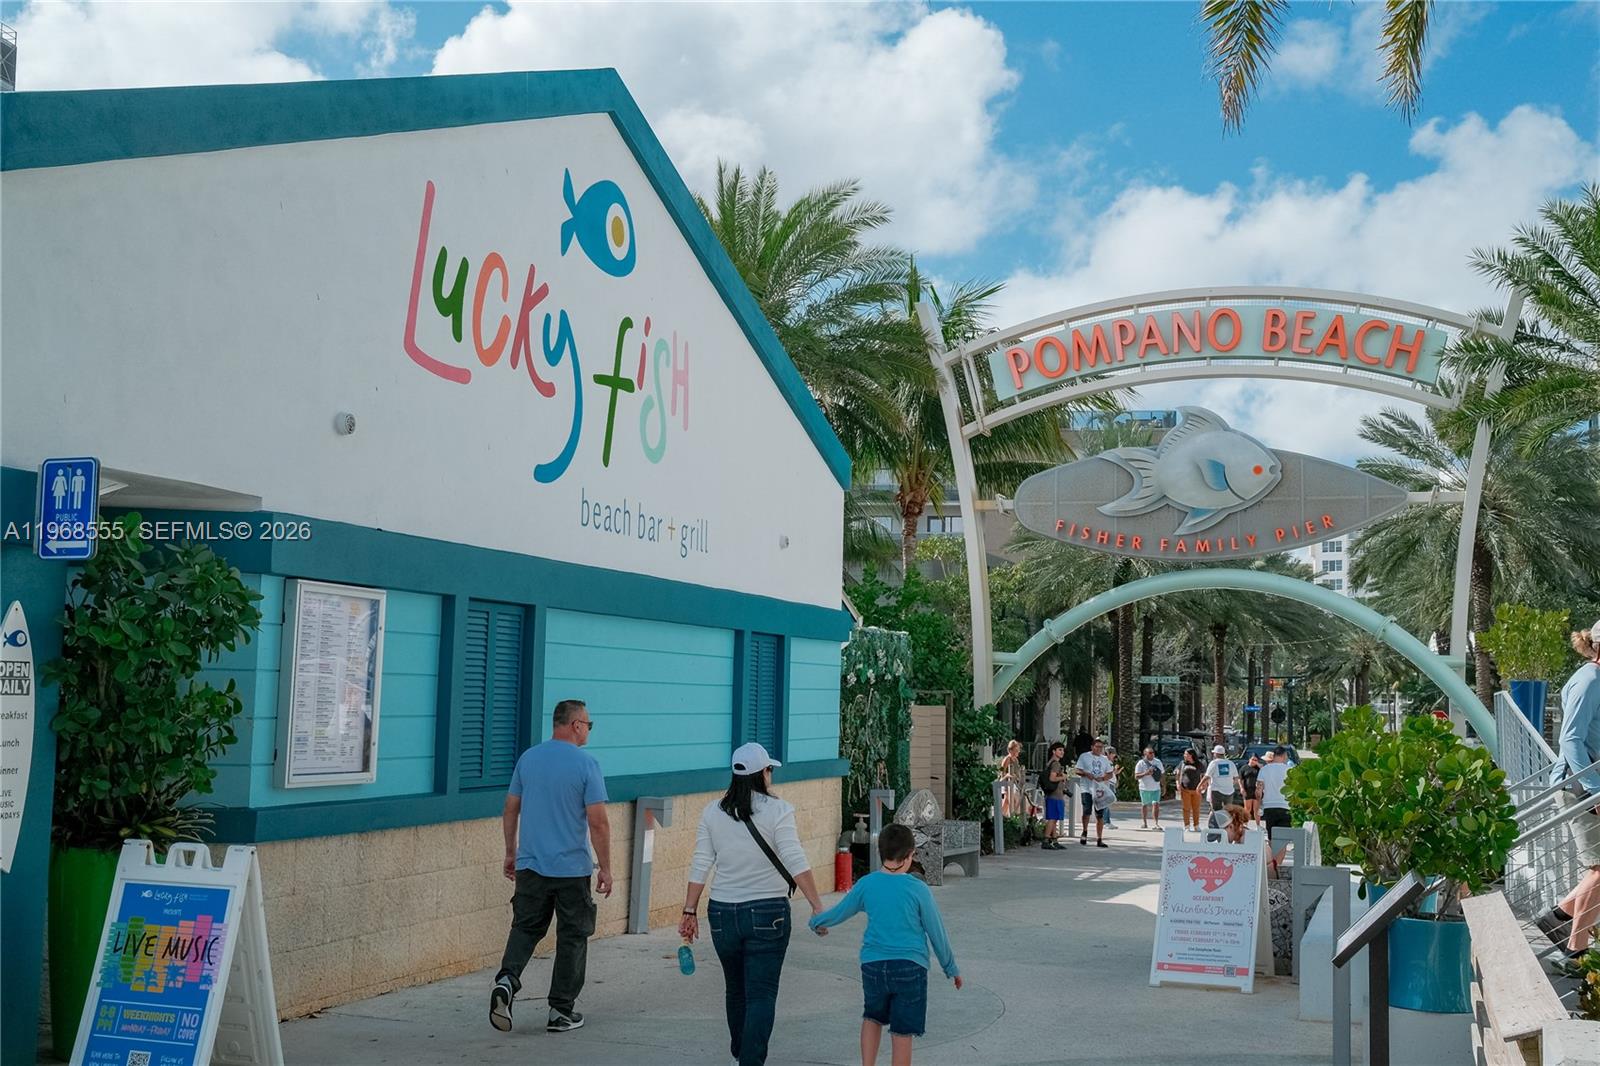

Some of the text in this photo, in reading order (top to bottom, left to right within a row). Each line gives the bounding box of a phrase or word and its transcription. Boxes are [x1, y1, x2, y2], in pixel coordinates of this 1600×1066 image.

[1005, 307, 1426, 389] POMPANO BEACH
[56, 514, 78, 522] PUBLIC
[580, 487, 632, 536] beach
[637, 502, 663, 543] bar
[680, 518, 709, 558] grill
[1055, 514, 1336, 554] FISHER FAMILY PIER
[0, 662, 30, 677] OPEN
[0, 679, 30, 694] AILY
[0, 767, 18, 775] nner
[0, 800, 15, 808] USIC
[1171, 902, 1245, 917] Valentine's Dinner
[113, 932, 219, 966] LIVE MUSIC
[123, 1009, 175, 1024] WEEKNIGHTS
[181, 1013, 200, 1028] NO
